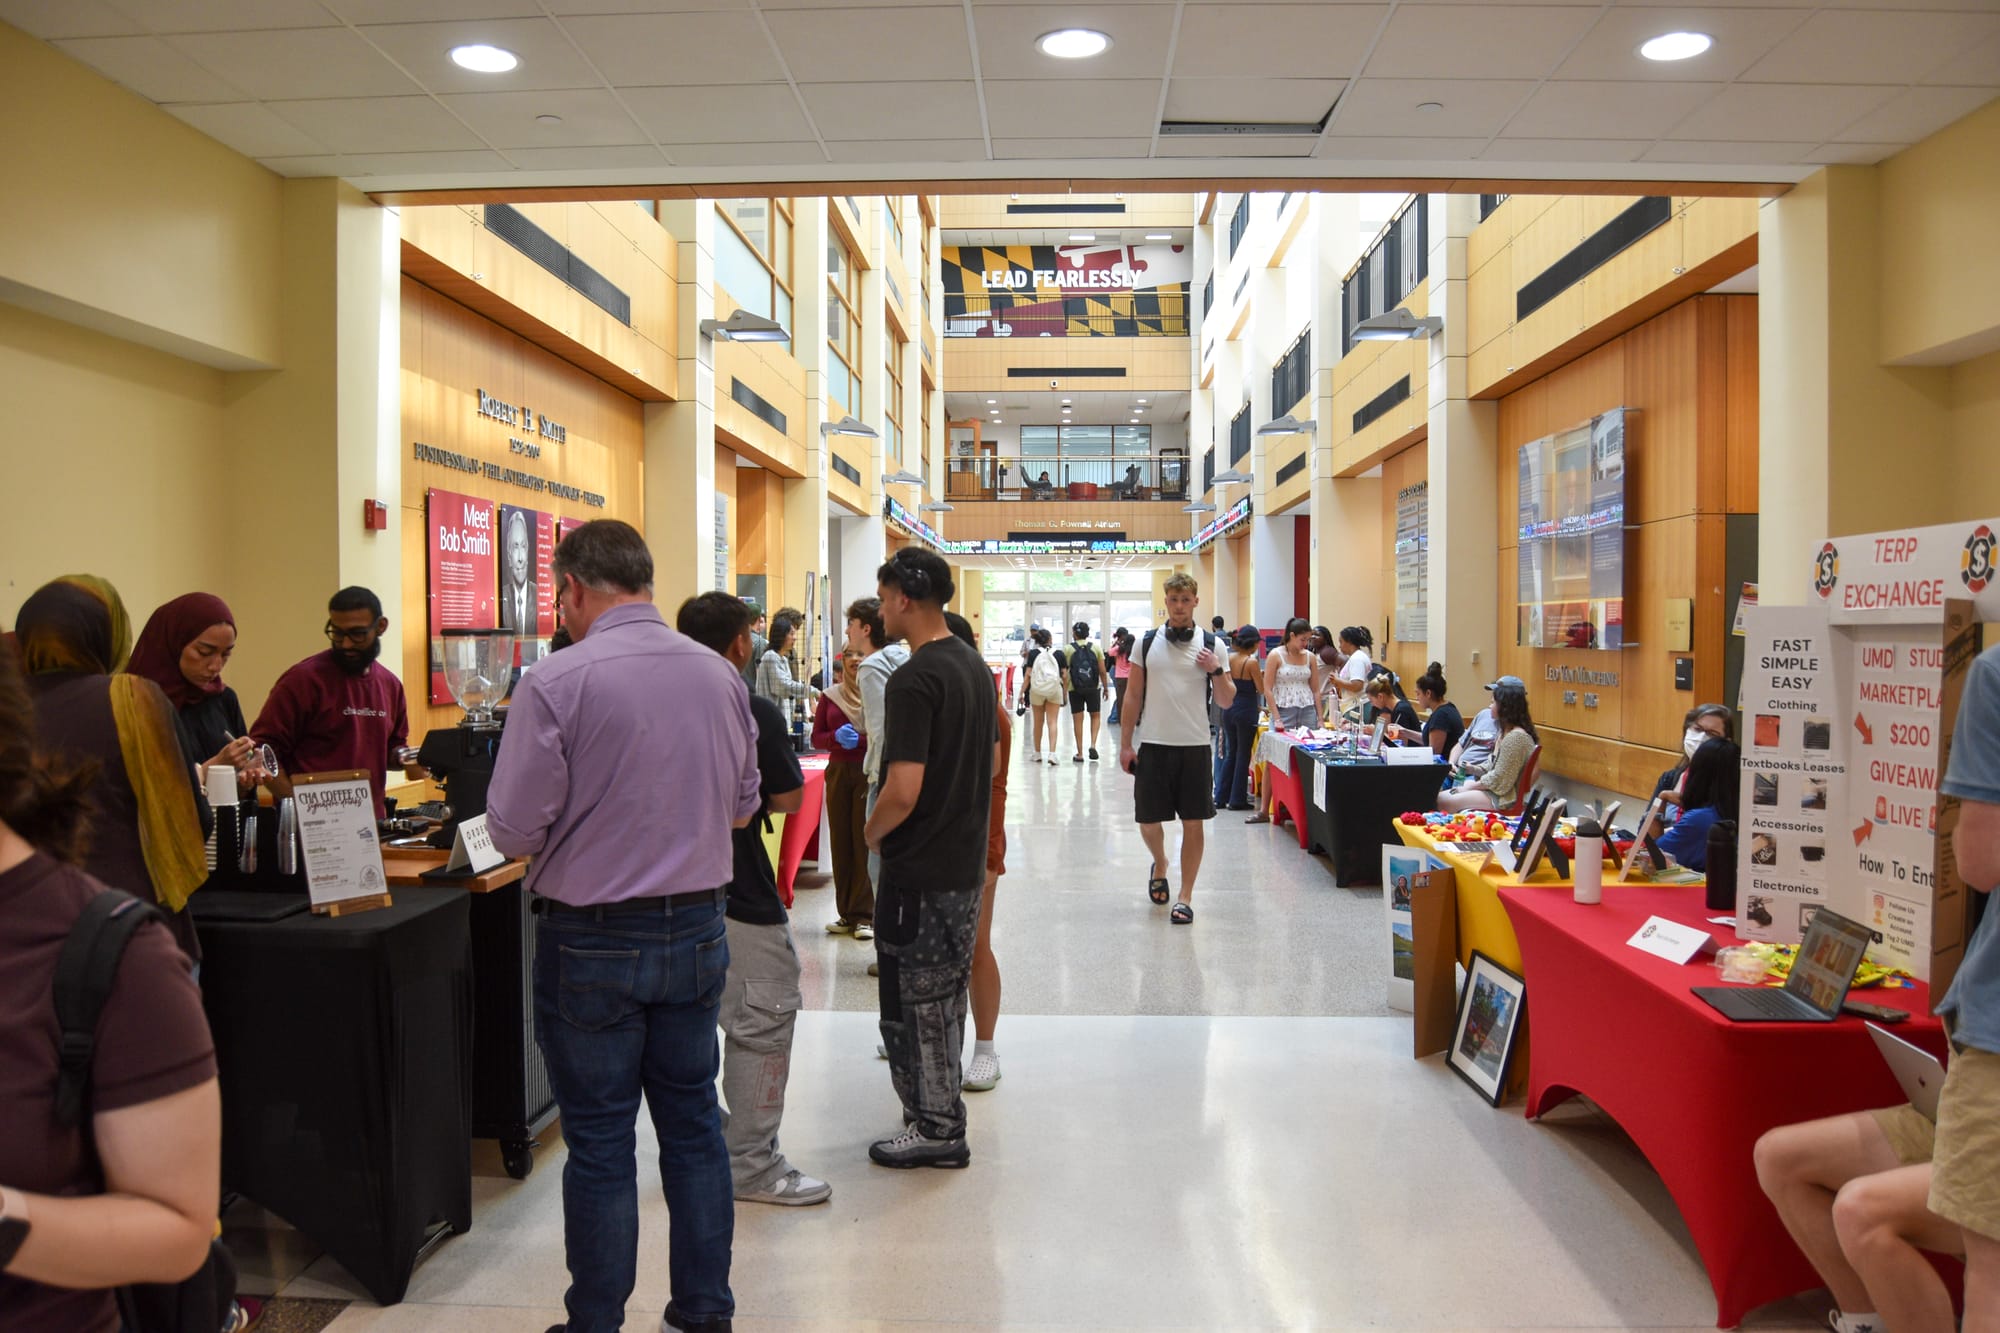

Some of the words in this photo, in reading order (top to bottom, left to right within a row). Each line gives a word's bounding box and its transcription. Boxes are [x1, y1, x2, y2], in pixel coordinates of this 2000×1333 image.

[982, 270, 1027, 288] LEAD
[1033, 270, 1142, 288] FEARLESSLY
[477, 388, 519, 426] ROBERT
[539, 413, 566, 444] SMITH
[414, 442, 478, 475] BUSINESSMAN
[464, 503, 490, 530] Meet
[440, 526, 460, 553] Bob
[462, 529, 490, 556] Smith
[1874, 537, 1918, 563] TERP
[1843, 579, 1944, 609] EXCHANGE
[1772, 639, 1812, 652] FAST
[1761, 657, 1819, 671] SIMPLE
[1862, 648, 1893, 669] UMD
[1771, 676, 1813, 690] EASY
[1768, 700, 1818, 713] Clothing
[1890, 722, 1930, 747] $200
[1741, 757, 1801, 771] Textbooks
[1803, 762, 1845, 774] Leases
[298, 792, 318, 805] CHA
[320, 788, 353, 802] COFFEE
[1890, 804, 1922, 829] LIVE
[1752, 818, 1824, 833] Accessories
[1859, 853, 1884, 875] How
[1892, 860, 1906, 880] To
[1753, 879, 1819, 895] Electronics
[1888, 902, 1907, 912] Follow
[1907, 907, 1915, 915] Us
[1888, 913, 1905, 924] Create
[1890, 924, 1912, 935] Account
[1886, 934, 1896, 943] Tag
[1901, 938, 1915, 948] UMD
[1890, 944, 1910, 956] Friends
